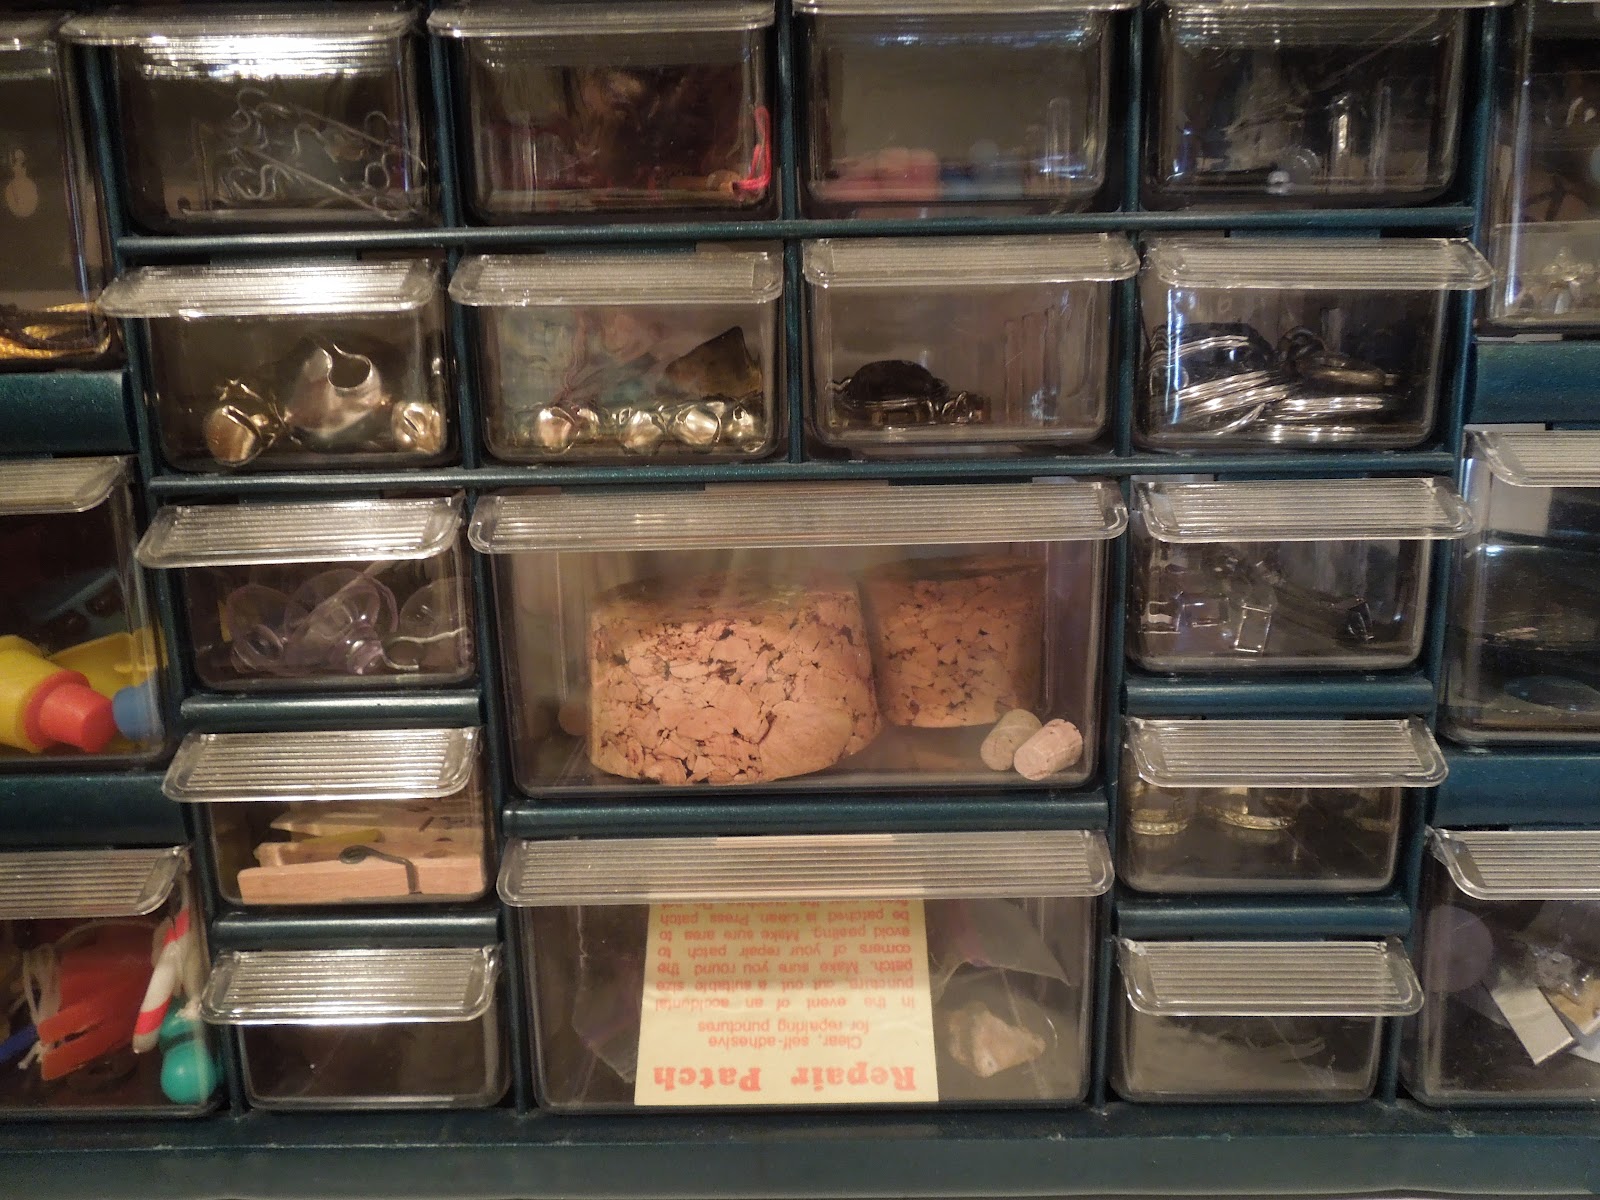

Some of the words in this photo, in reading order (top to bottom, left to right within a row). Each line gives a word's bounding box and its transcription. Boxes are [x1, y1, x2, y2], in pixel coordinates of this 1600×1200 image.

[660, 911, 698, 926] patch
[659, 930, 672, 942] to
[684, 930, 715, 940] area
[873, 926, 911, 938] avoid
[657, 946, 672, 958] to
[687, 944, 728, 959] patch
[738, 944, 781, 958] repair
[790, 942, 821, 956] your
[833, 944, 848, 957] of
[859, 944, 912, 954] corners
[657, 962, 680, 976] the
[694, 963, 736, 977] round
[743, 960, 769, 974] you
[778, 962, 809, 973] sure
[820, 960, 859, 974] Make
[656, 980, 685, 992] size
[745, 998, 764, 1008] an
[776, 998, 790, 1012] of
[806, 997, 847, 1011] event
[864, 997, 887, 1009] the
[902, 996, 915, 1009] In
[698, 1018, 770, 1033] punctures
[777, 1018, 843, 1035] repairing
[851, 1020, 869, 1035] for
[708, 1036, 810, 1050] self-adhesive
[818, 1034, 862, 1050] Clear,
[653, 1066, 762, 1092] Patch
[791, 1061, 917, 1092] Repair
